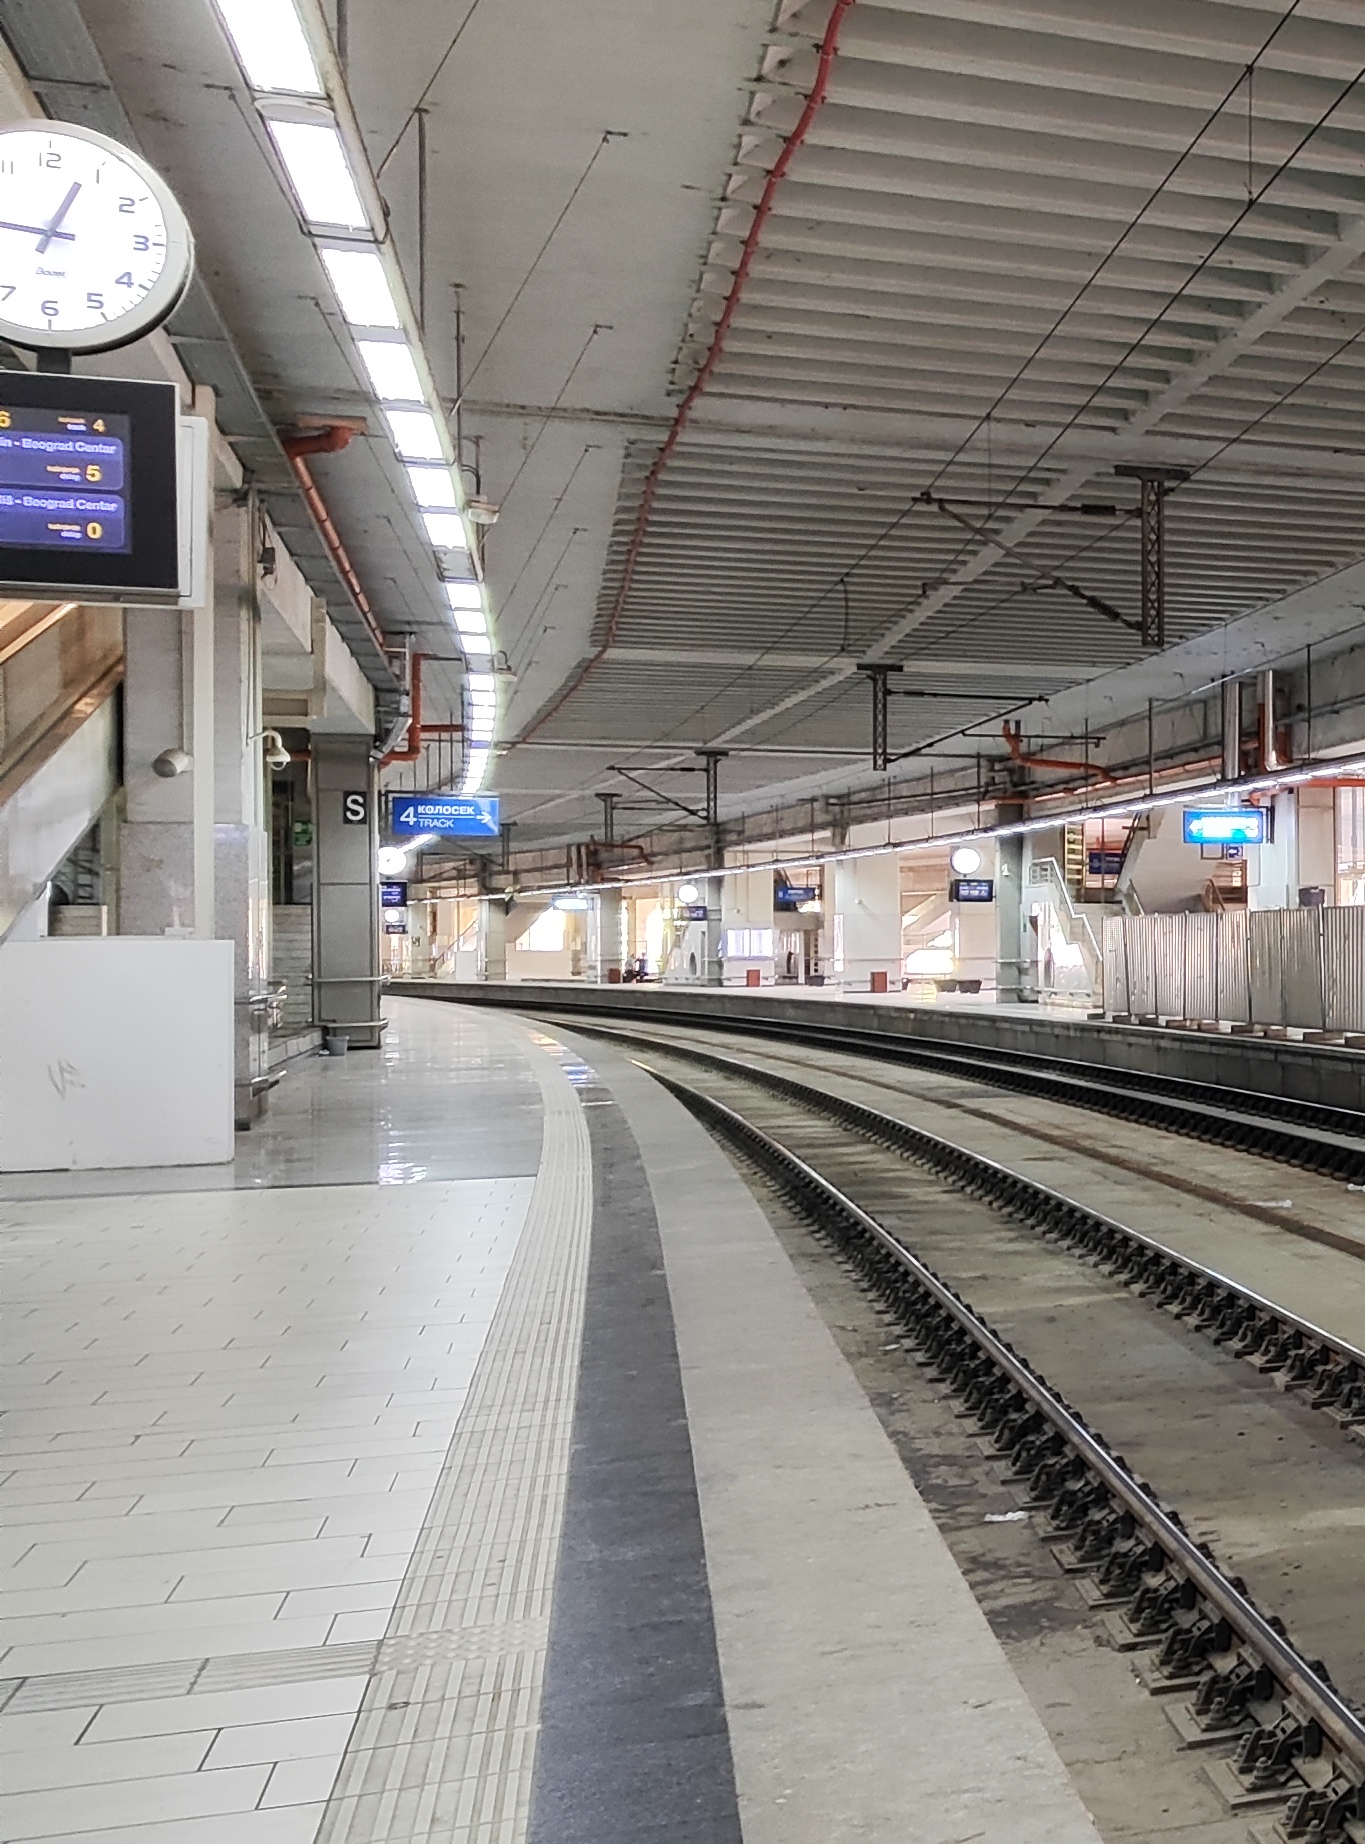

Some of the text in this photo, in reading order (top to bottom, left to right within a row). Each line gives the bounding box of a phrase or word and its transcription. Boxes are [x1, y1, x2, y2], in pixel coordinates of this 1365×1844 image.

[2, 160, 13, 174] 11
[39, 152, 61, 169] 12
[119, 197, 135, 213] 2
[133, 235, 149, 251] 3
[115, 272, 134, 288] 4
[41, 300, 59, 316] 6
[87, 293, 104, 309] 5
[93, 419, 106, 432] 4
[22, 438, 74, 452] Beograd
[75, 442, 117, 454] Centar
[86, 464, 102, 481] 5
[23, 496, 74, 509] Beograd
[76, 500, 118, 512] Centar
[86, 522, 102, 539] 0
[346, 795, 365, 821] S
[400, 806, 417, 826] 4
[418, 805, 475, 815] КОЛОСЕК
[418, 819, 454, 828] TRACK
